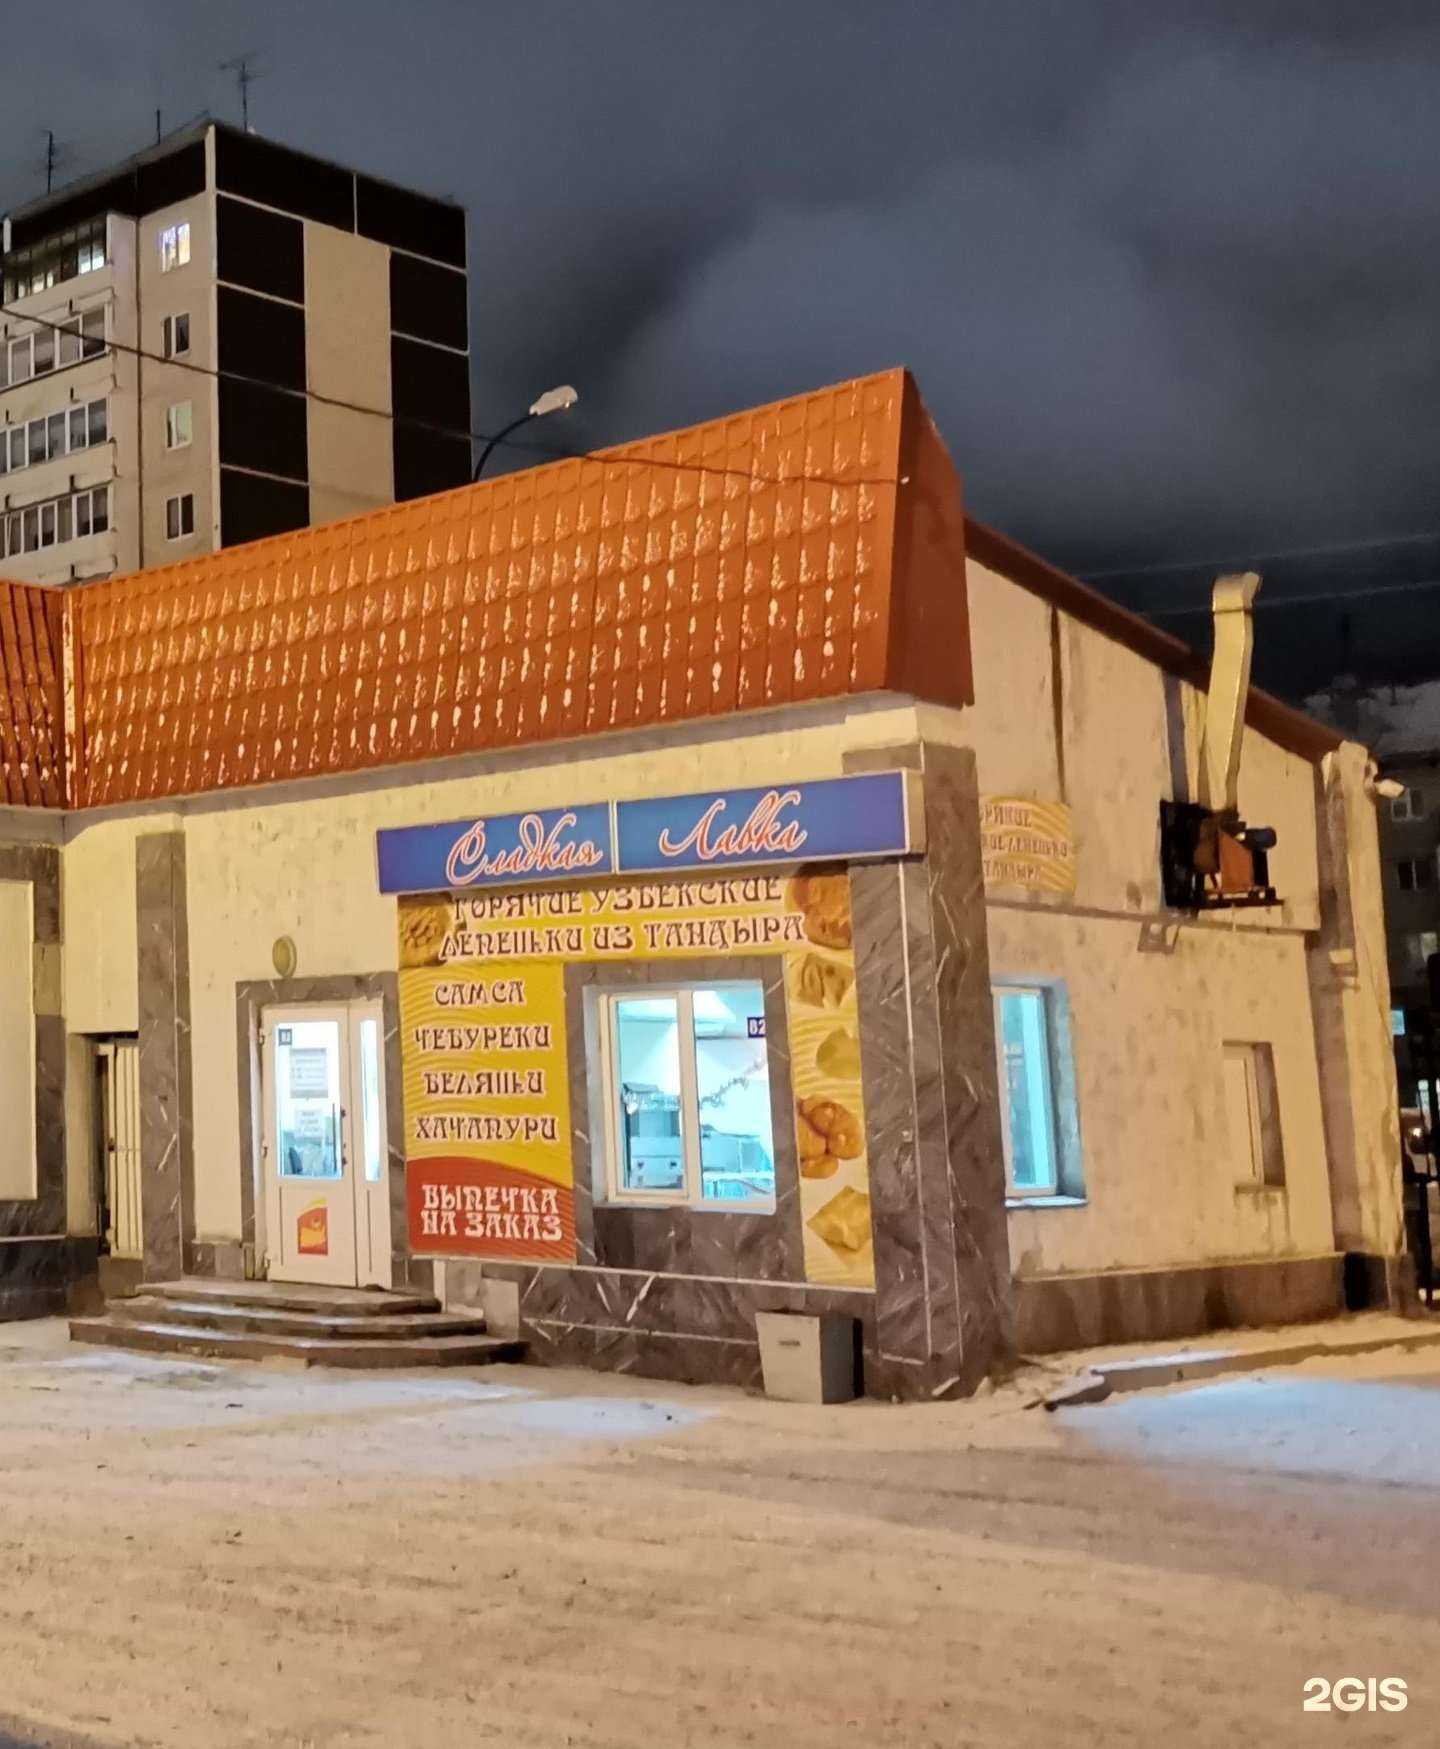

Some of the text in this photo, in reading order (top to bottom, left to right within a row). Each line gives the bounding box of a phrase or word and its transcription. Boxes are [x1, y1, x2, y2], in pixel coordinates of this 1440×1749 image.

[446, 790, 807, 886] Сладкая Лавка
[453, 874, 783, 921] ГОРЯЧИЕ УЗБЕКСКИЕ
[440, 915, 805, 960] ЛЕПЕШКИ ИЗ ТАНДЫРА
[434, 979, 526, 1006] САМСА
[415, 1024, 551, 1051] ЧЕБУРЕКИ
[424, 1071, 545, 1096] БЕЛЯШИ
[415, 1116, 559, 1141] ХАЧАПУРИ
[422, 1184, 559, 1214] ВЫПЕЧКА
[421, 1209, 563, 1241] НА ЗАКАЗ
